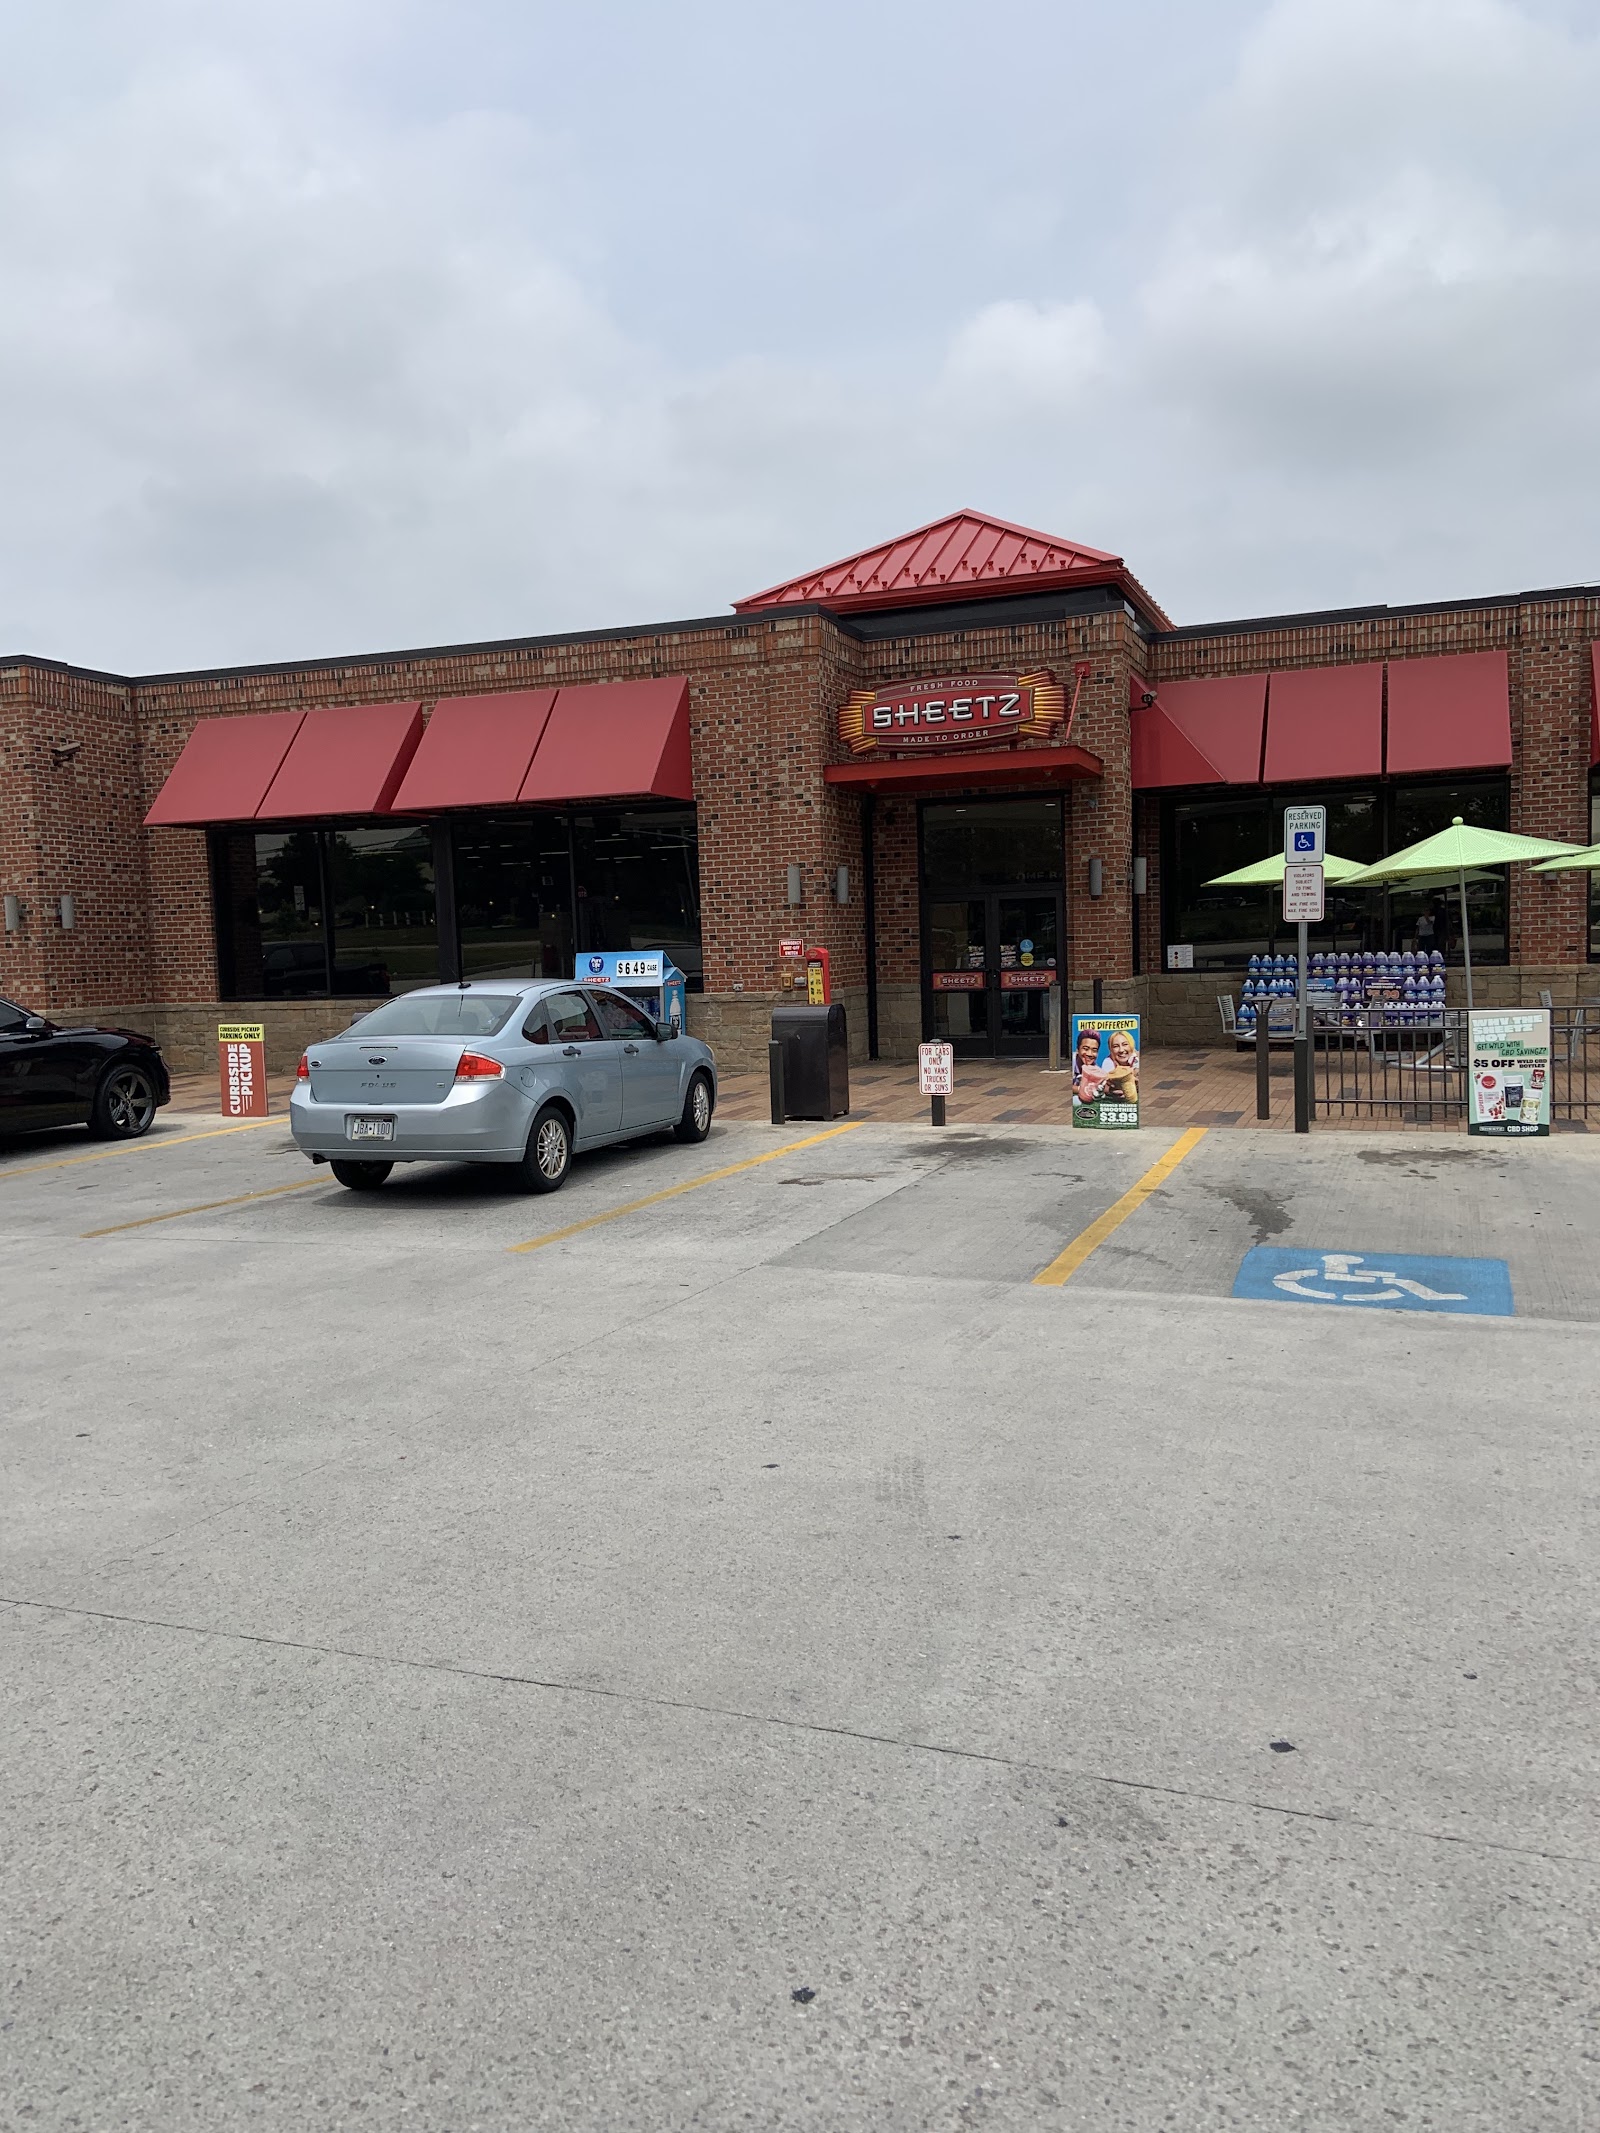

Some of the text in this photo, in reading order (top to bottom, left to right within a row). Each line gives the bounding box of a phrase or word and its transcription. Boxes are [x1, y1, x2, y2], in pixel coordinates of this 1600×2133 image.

[910, 679, 978, 692] FRESH FOOD
[873, 693, 1020, 728] SHEETZ
[953, 730, 989, 740] ORDER
[1288, 811, 1322, 821] RESERVED
[1289, 821, 1321, 830] PARKING
[1080, 1020, 1135, 1030] HITS DIFFERENT
[1472, 1014, 1543, 1027] WHY THE
[1472, 1024, 1533, 1035] SHEETZ
[1473, 1033, 1507, 1043] NOT
[1477, 1043, 1487, 1051] GET
[1506, 1040, 1521, 1048] WITH
[921, 1047, 950, 1056] FOR CARS
[1516, 1048, 1547, 1056] SAVINGZ?
[928, 1057, 943, 1066] ONLY
[1474, 1058, 1489, 1068] $5
[1491, 1059, 1515, 1068] OFF
[239, 1043, 253, 1095] PICKUP
[923, 1067, 949, 1075] NO VANS
[227, 1043, 241, 1114] CURBSIDE
[926, 1075, 947, 1083] TRUCKS
[924, 1083, 949, 1092] OR SUVS
[1100, 1112, 1138, 1123] $3.99
